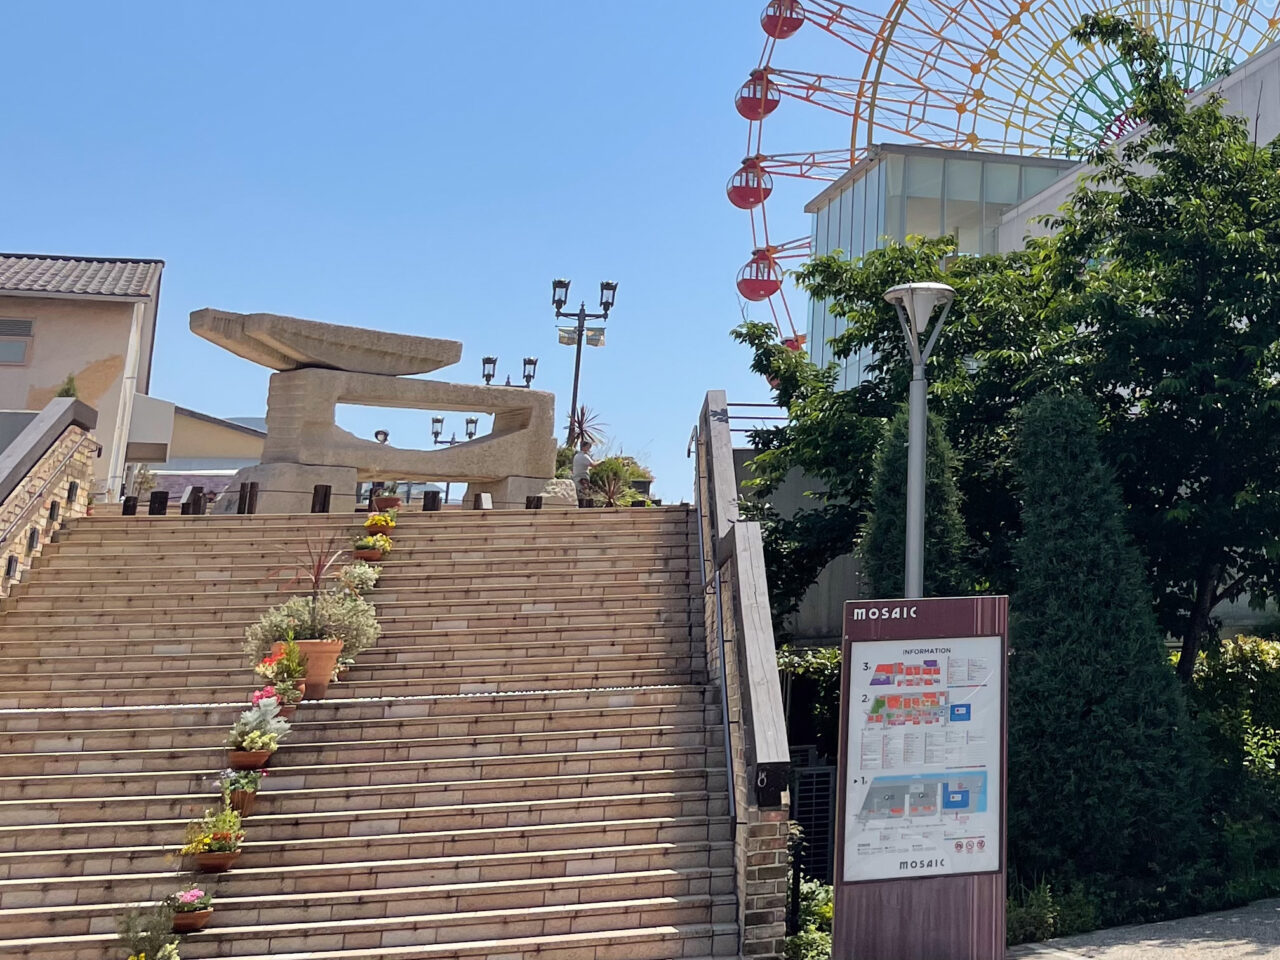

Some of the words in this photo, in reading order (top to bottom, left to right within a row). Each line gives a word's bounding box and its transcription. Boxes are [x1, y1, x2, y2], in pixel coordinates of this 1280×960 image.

[853, 606, 918, 620] MOSAIC
[903, 647, 951, 656] INFORMATION
[899, 858, 945, 870] MOSAIC
